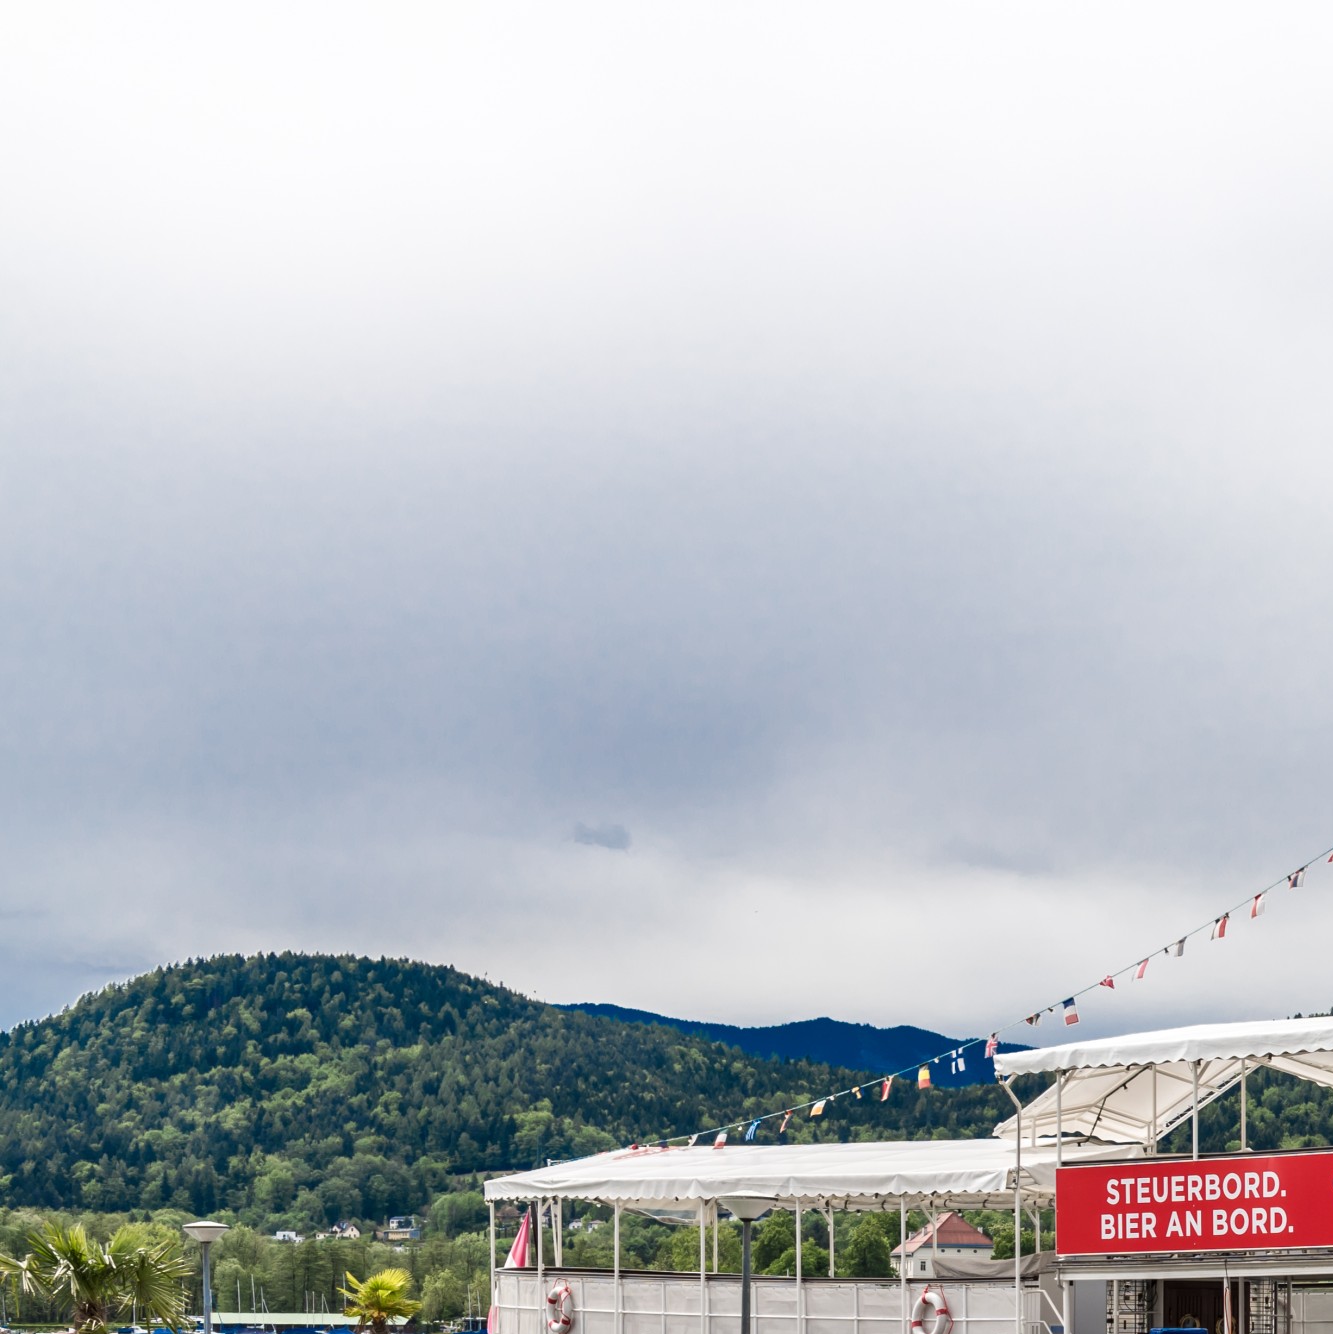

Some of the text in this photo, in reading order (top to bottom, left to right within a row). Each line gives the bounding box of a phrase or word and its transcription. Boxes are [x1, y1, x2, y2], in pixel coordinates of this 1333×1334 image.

[1106, 1171, 1287, 1205] STEUERBORD.
[1100, 1206, 1294, 1240] BIER AN BORD.
